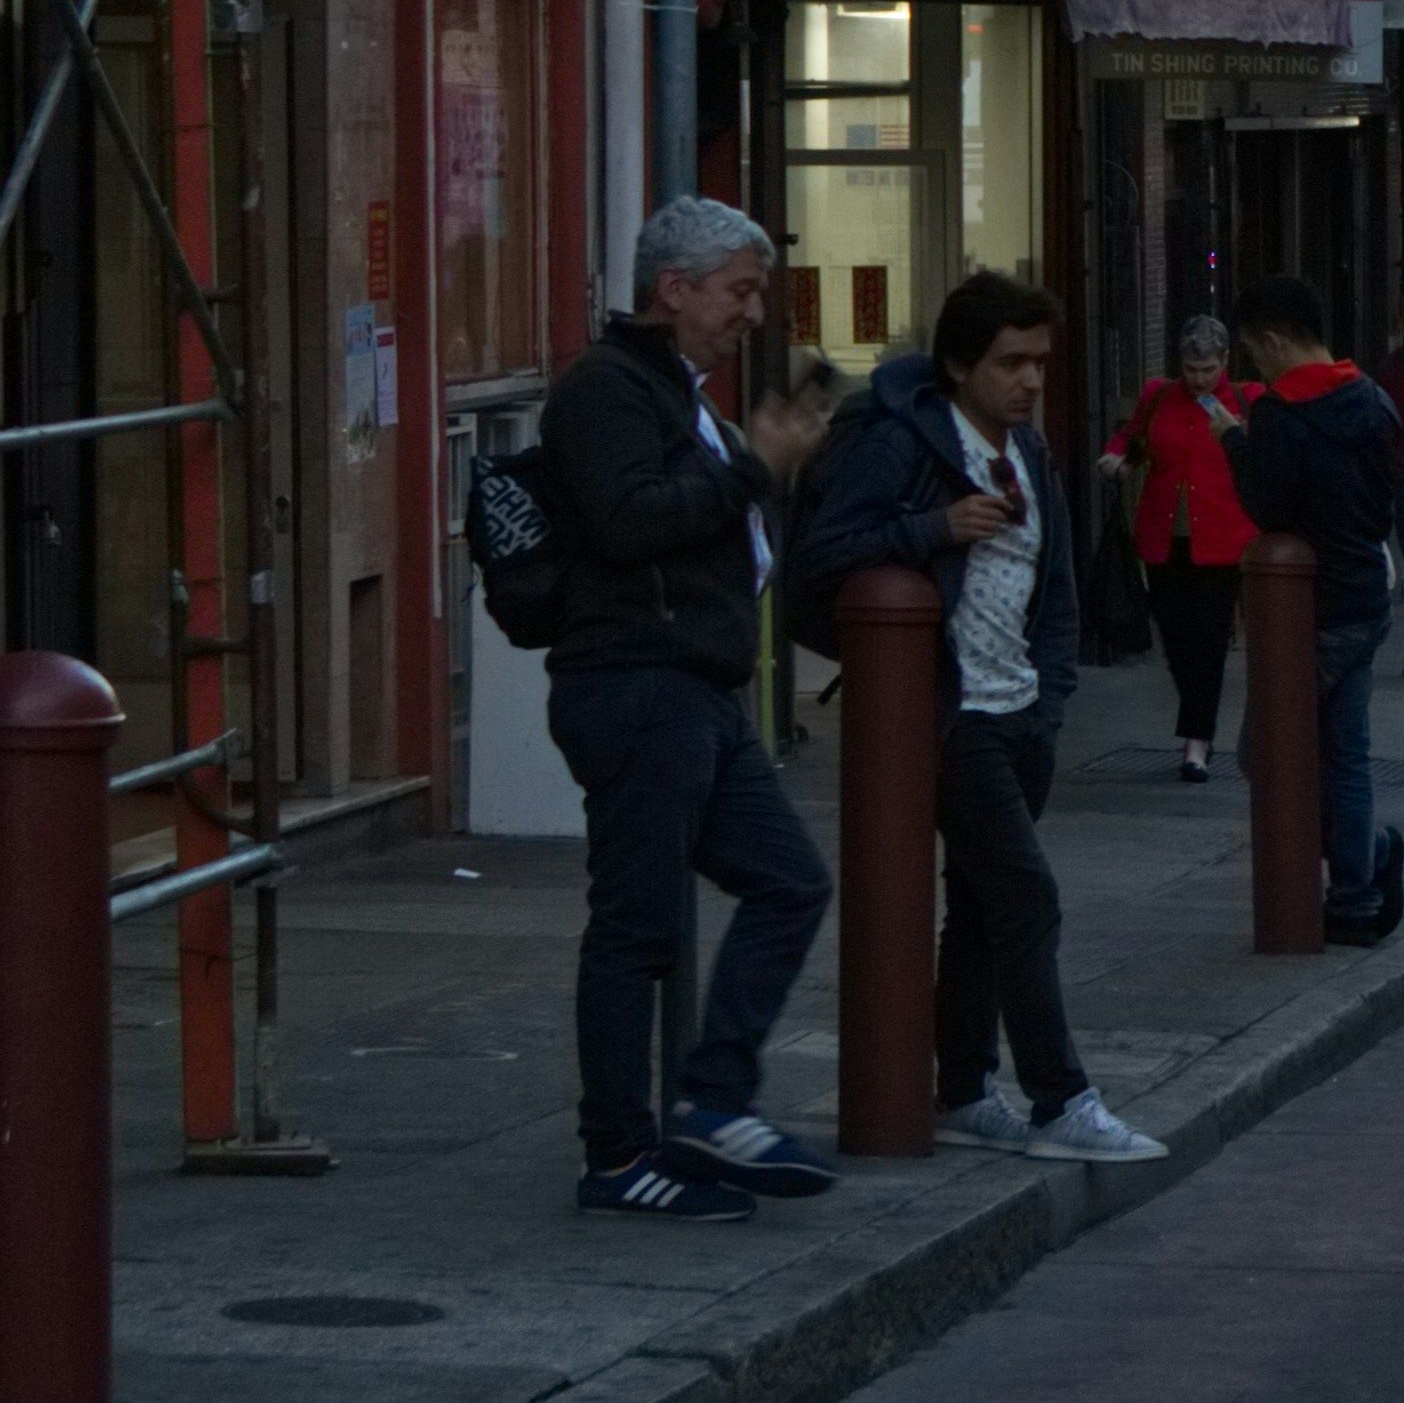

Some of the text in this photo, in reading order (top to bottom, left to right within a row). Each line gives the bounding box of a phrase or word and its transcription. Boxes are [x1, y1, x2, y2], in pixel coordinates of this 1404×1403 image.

[1110, 53, 1145, 73] TIN
[1151, 54, 1215, 74] SHING
[1224, 55, 1320, 76] PRINTING
